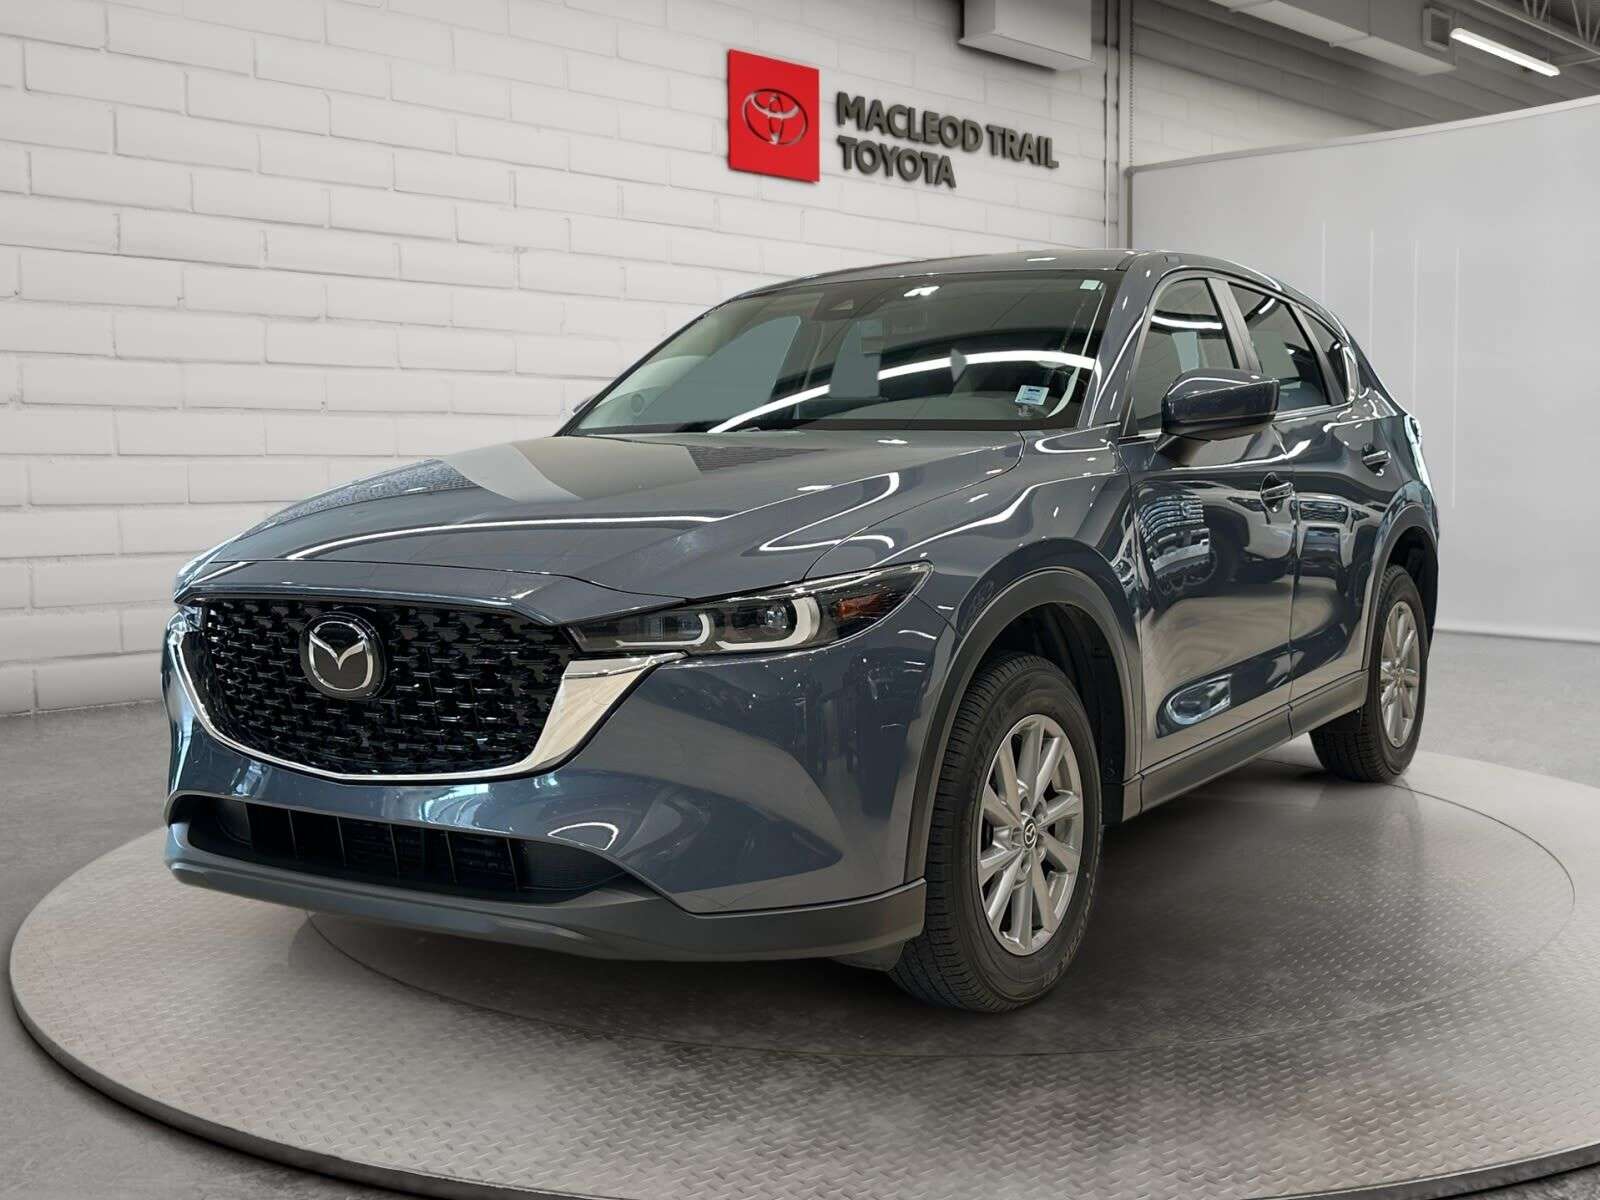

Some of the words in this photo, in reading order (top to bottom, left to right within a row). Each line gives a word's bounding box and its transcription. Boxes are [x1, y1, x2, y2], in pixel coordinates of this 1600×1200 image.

[836, 91, 983, 152] MACLEOD
[987, 124, 1059, 169] TRAIL
[837, 135, 956, 188] TOYOTA
